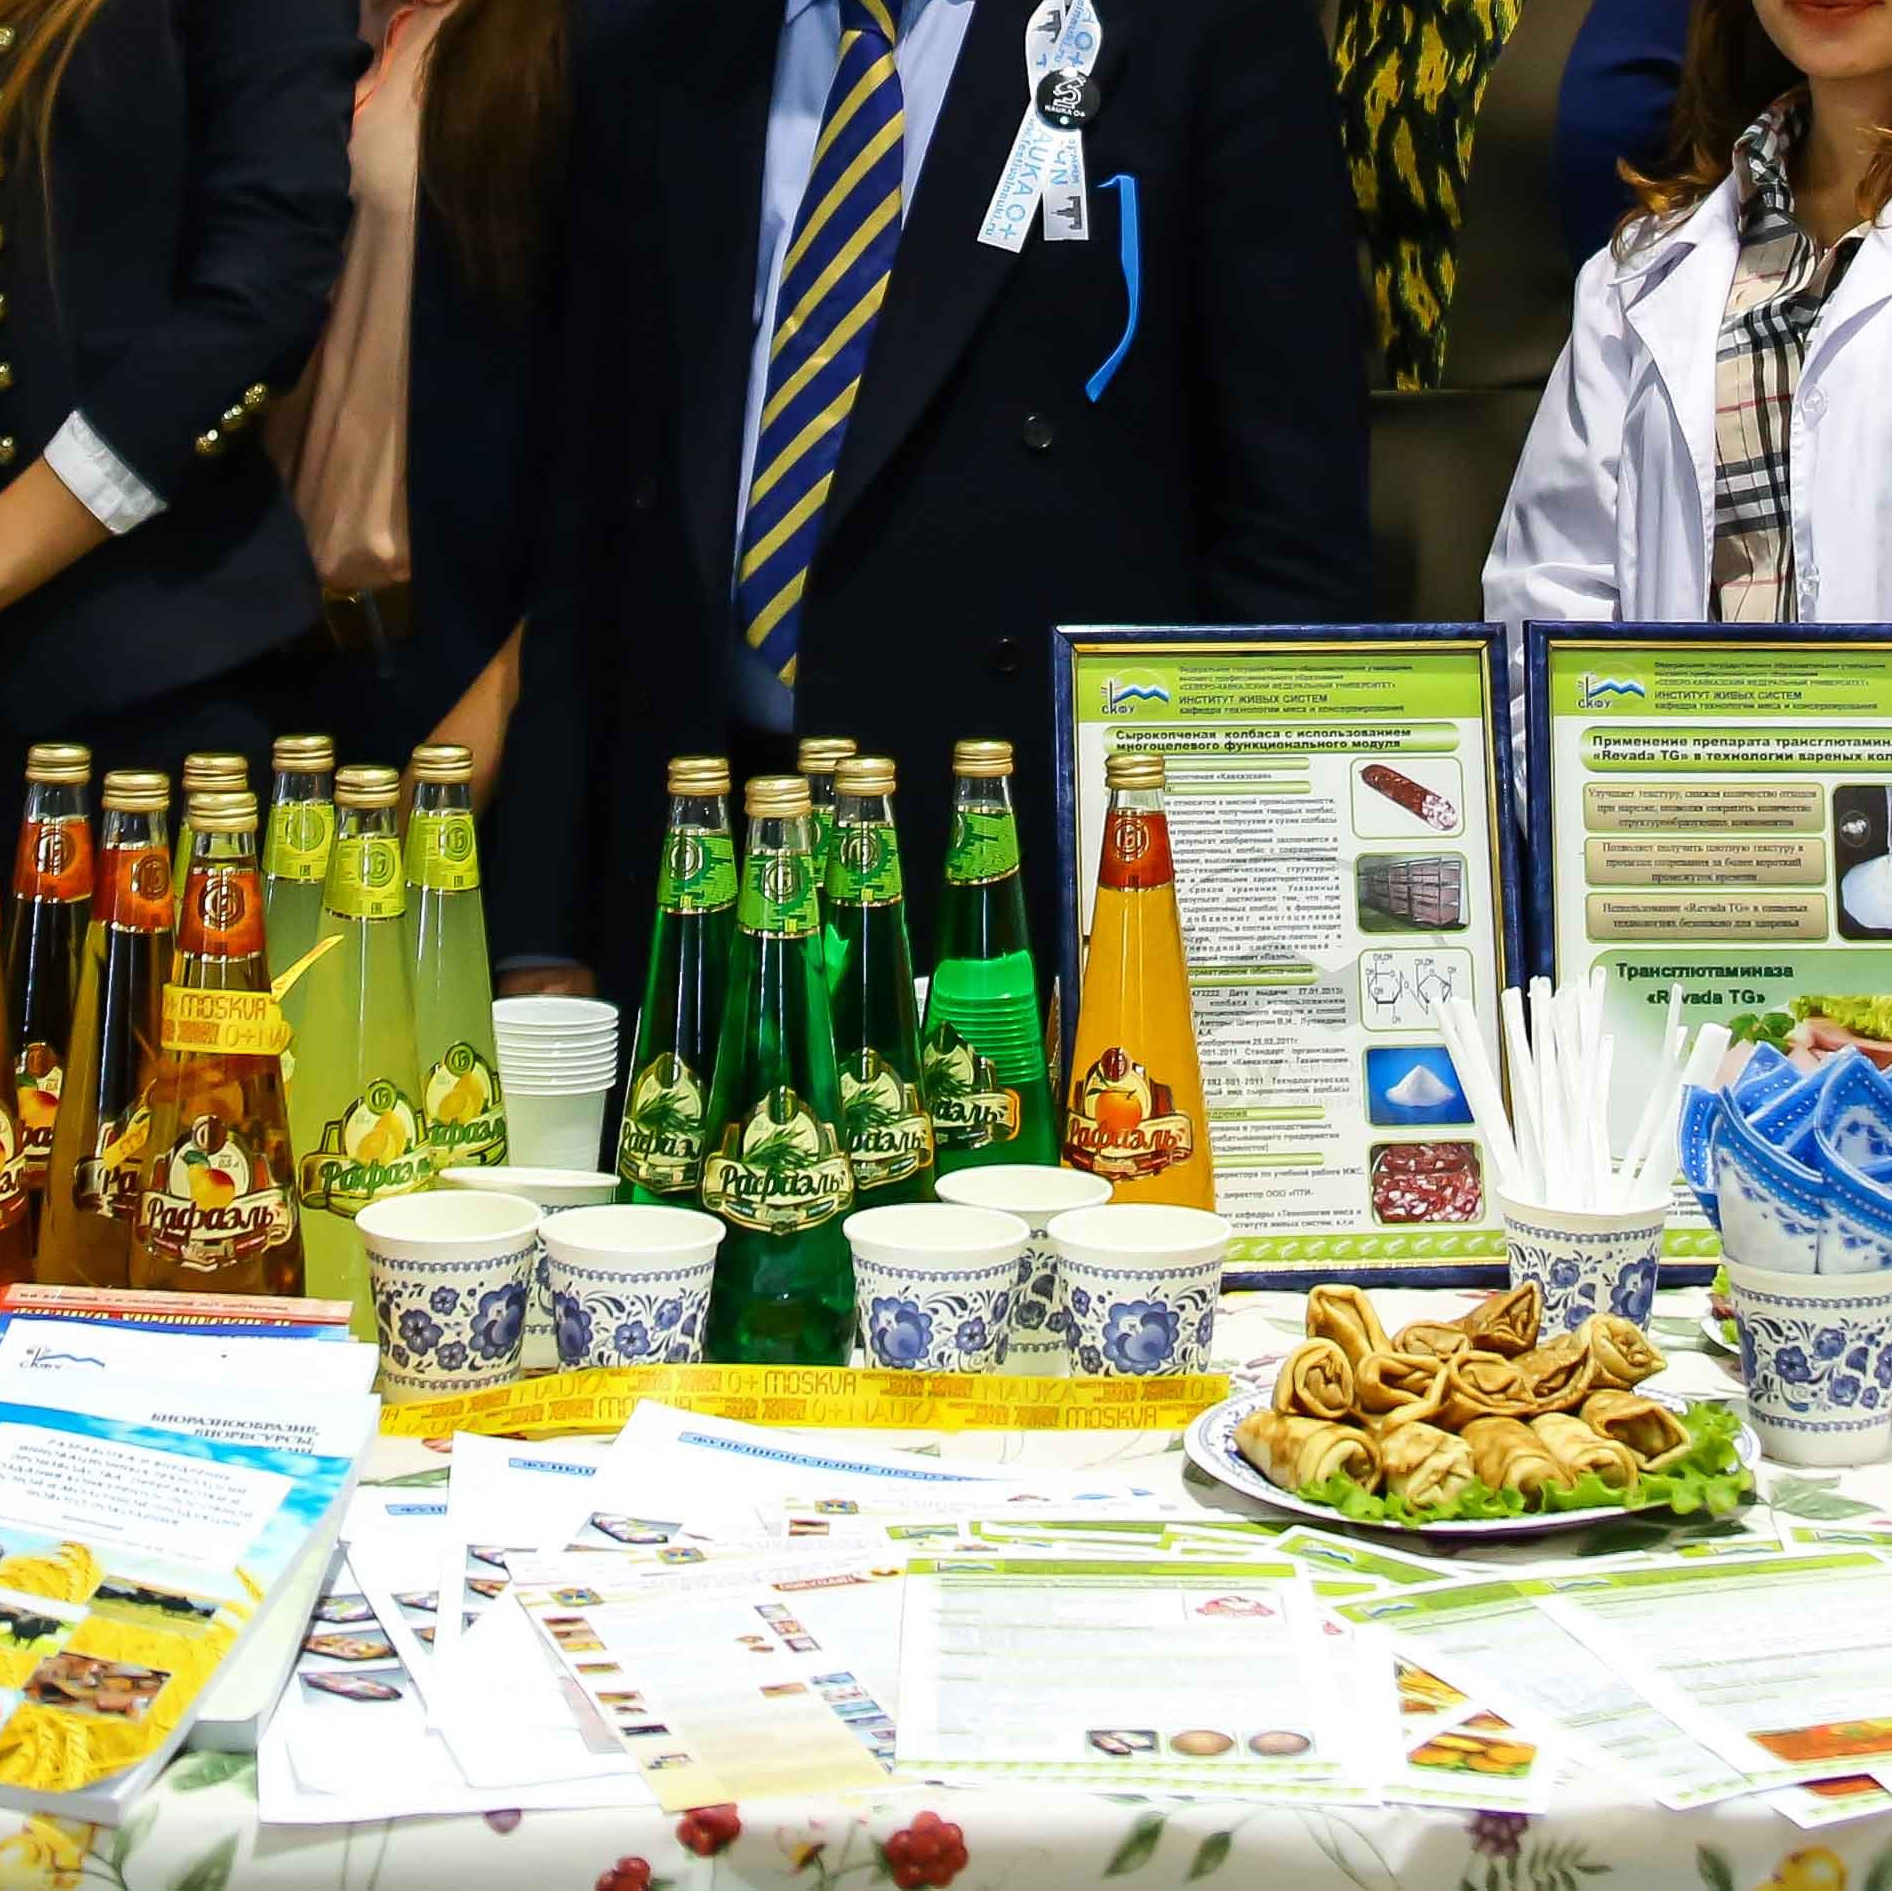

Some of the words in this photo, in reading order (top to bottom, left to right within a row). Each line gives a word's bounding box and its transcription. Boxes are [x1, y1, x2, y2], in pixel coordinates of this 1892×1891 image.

[1014, 129, 1054, 197] AUKA
[1116, 730, 1216, 743] Сырокопченая
[1225, 729, 1280, 741] колбаса
[1297, 727, 1411, 741] использованием
[1593, 735, 1688, 748] Применение
[1693, 737, 1769, 749] препарата
[1116, 741, 1219, 752] многоцелевого
[1225, 739, 1347, 752] функционального
[1351, 739, 1400, 751] модуля
[1707, 752, 1793, 763] технологии
[1798, 752, 1863, 762] вареных
[1616, 962, 1793, 981] Трансглютаминаза
[1646, 990, 1723, 1006] «Rvada
[1728, 989, 1766, 1005] TG»
[181, 993, 266, 1022] MOSKVA
[145, 1198, 274, 1239] Рафаэль
[764, 1370, 857, 1397] MOSKVA
[1066, 1406, 1157, 1428] MOSKVA
